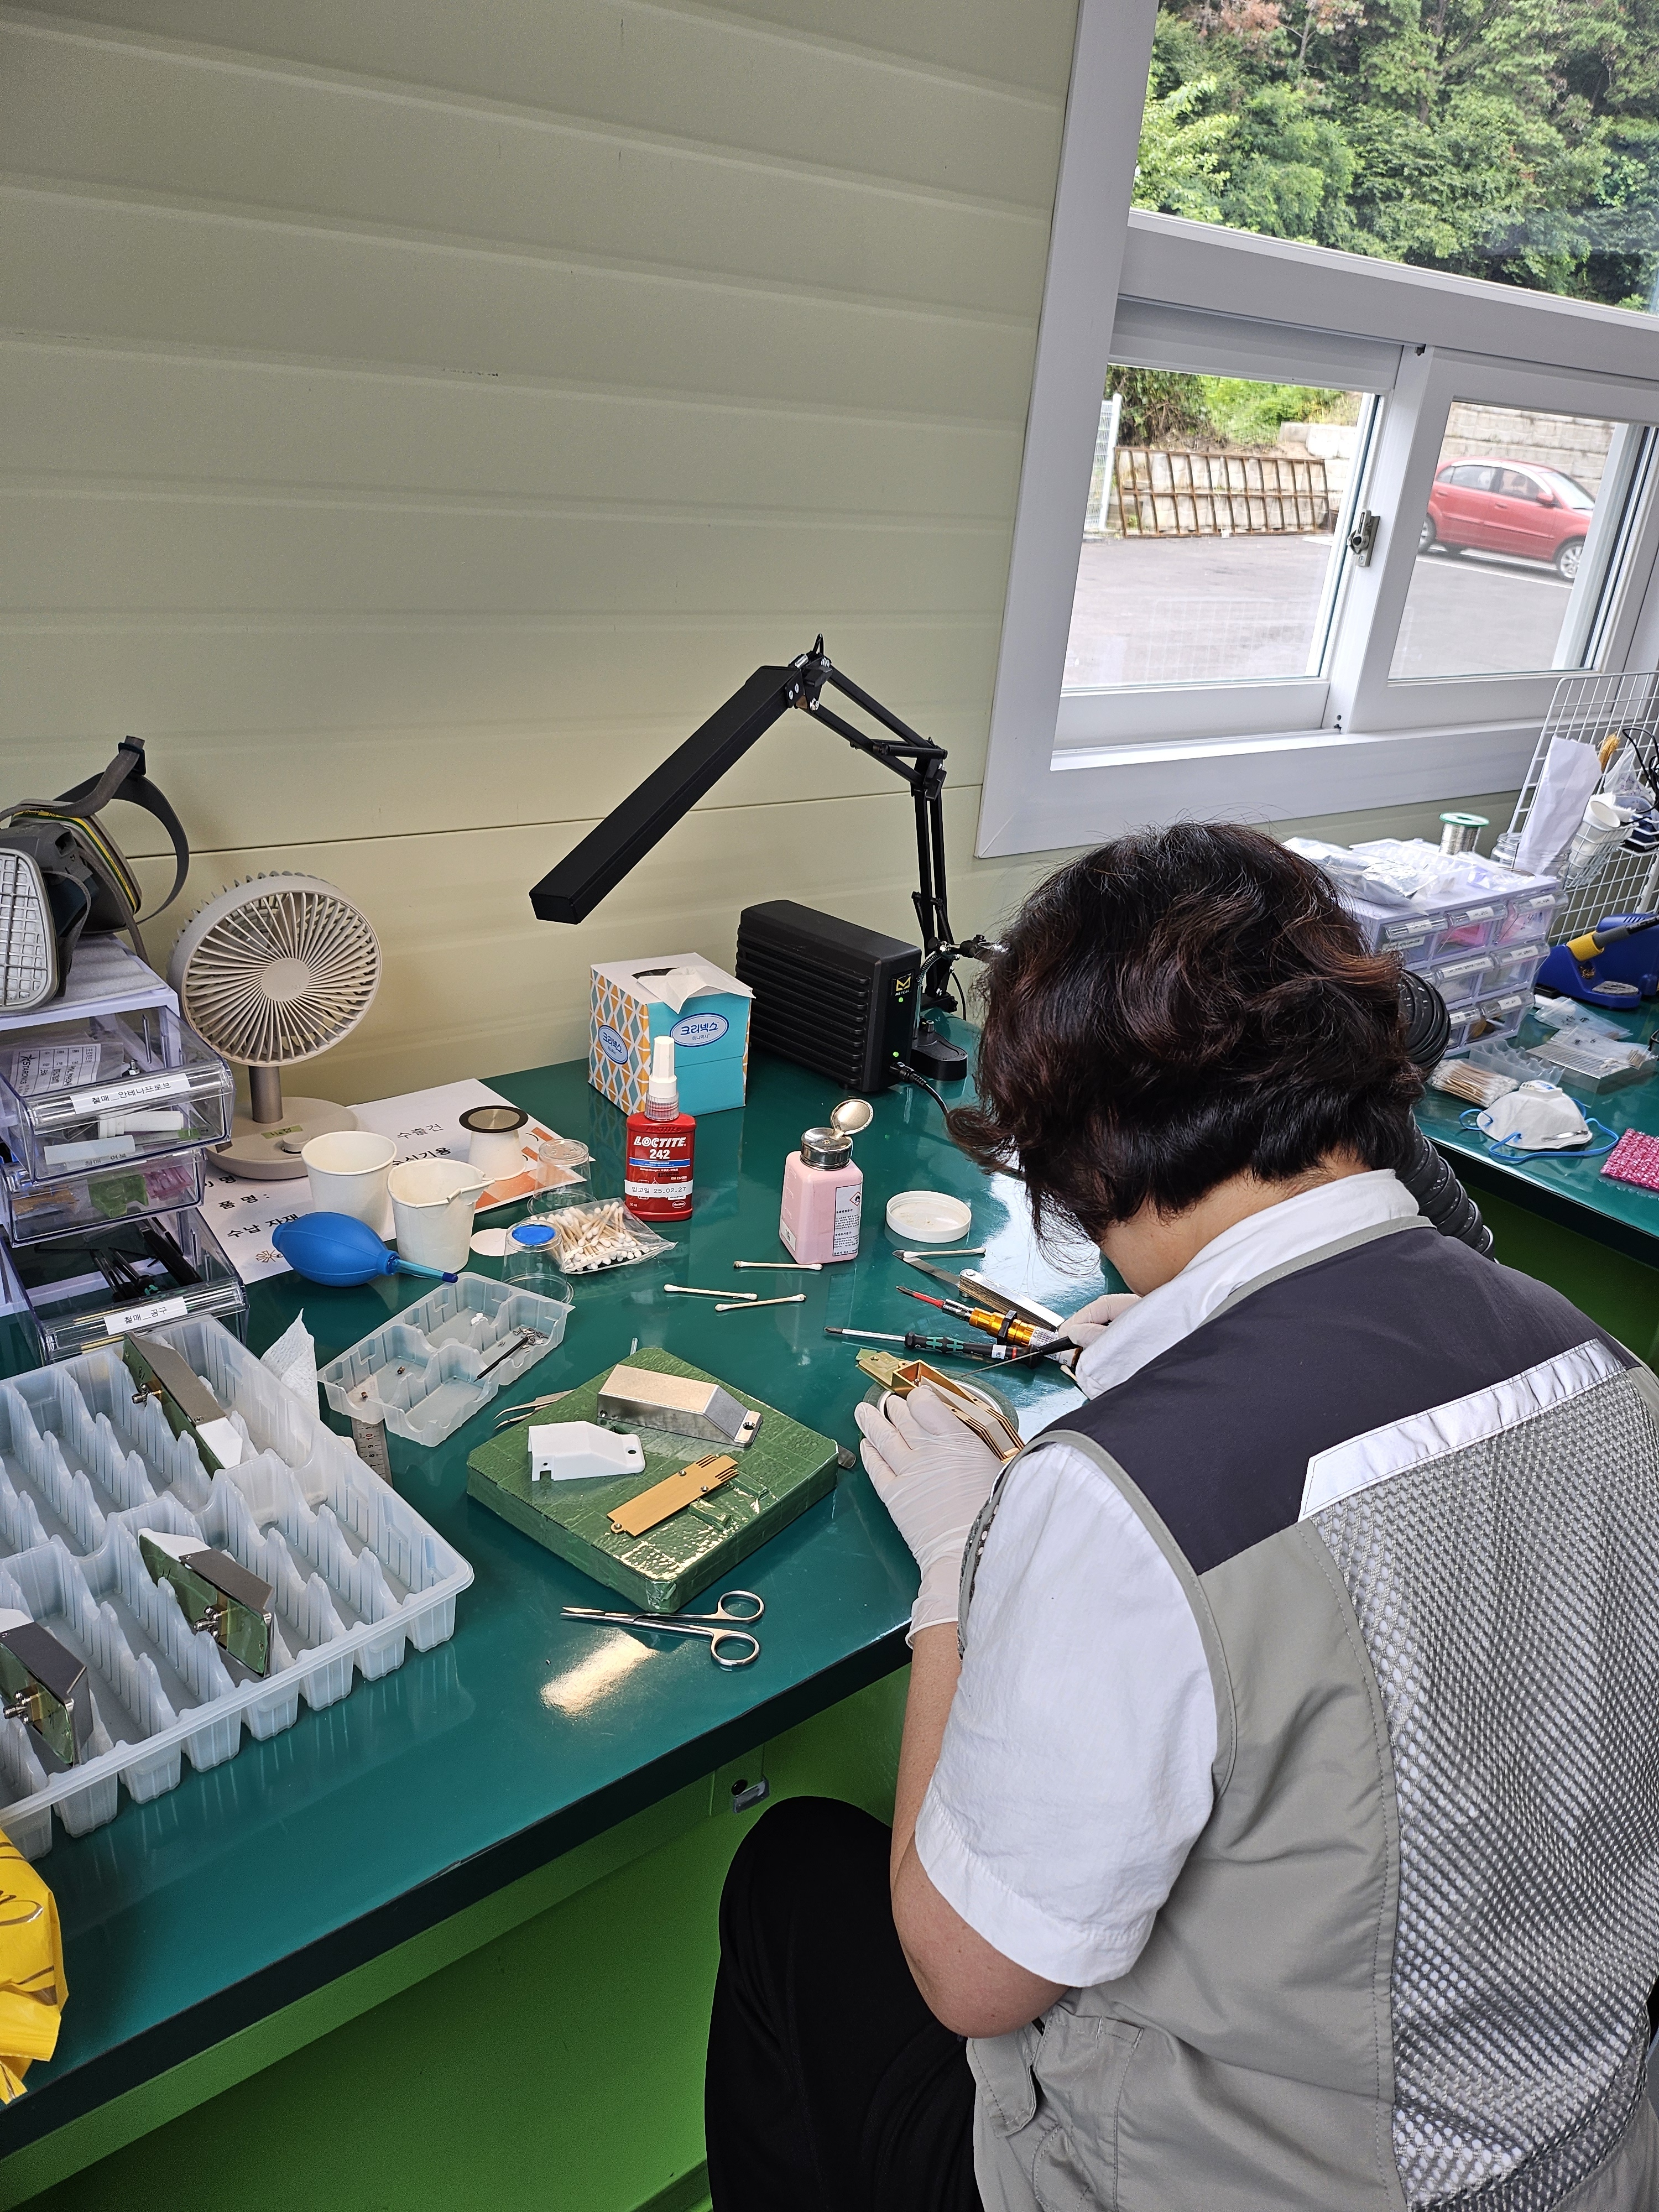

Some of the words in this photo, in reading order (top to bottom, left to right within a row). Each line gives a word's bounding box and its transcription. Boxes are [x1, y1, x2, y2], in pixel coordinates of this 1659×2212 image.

[681, 1022, 718, 1035] 크리넥스
[603, 1032, 622, 1053] 크리넥스
[397, 1123, 444, 1139] 수출건
[634, 1136, 686, 1147] LOCTITE
[649, 1149, 670, 1159] 242
[227, 1224, 262, 1238] 수납
[124, 1307, 168, 1324] 철매_공구
